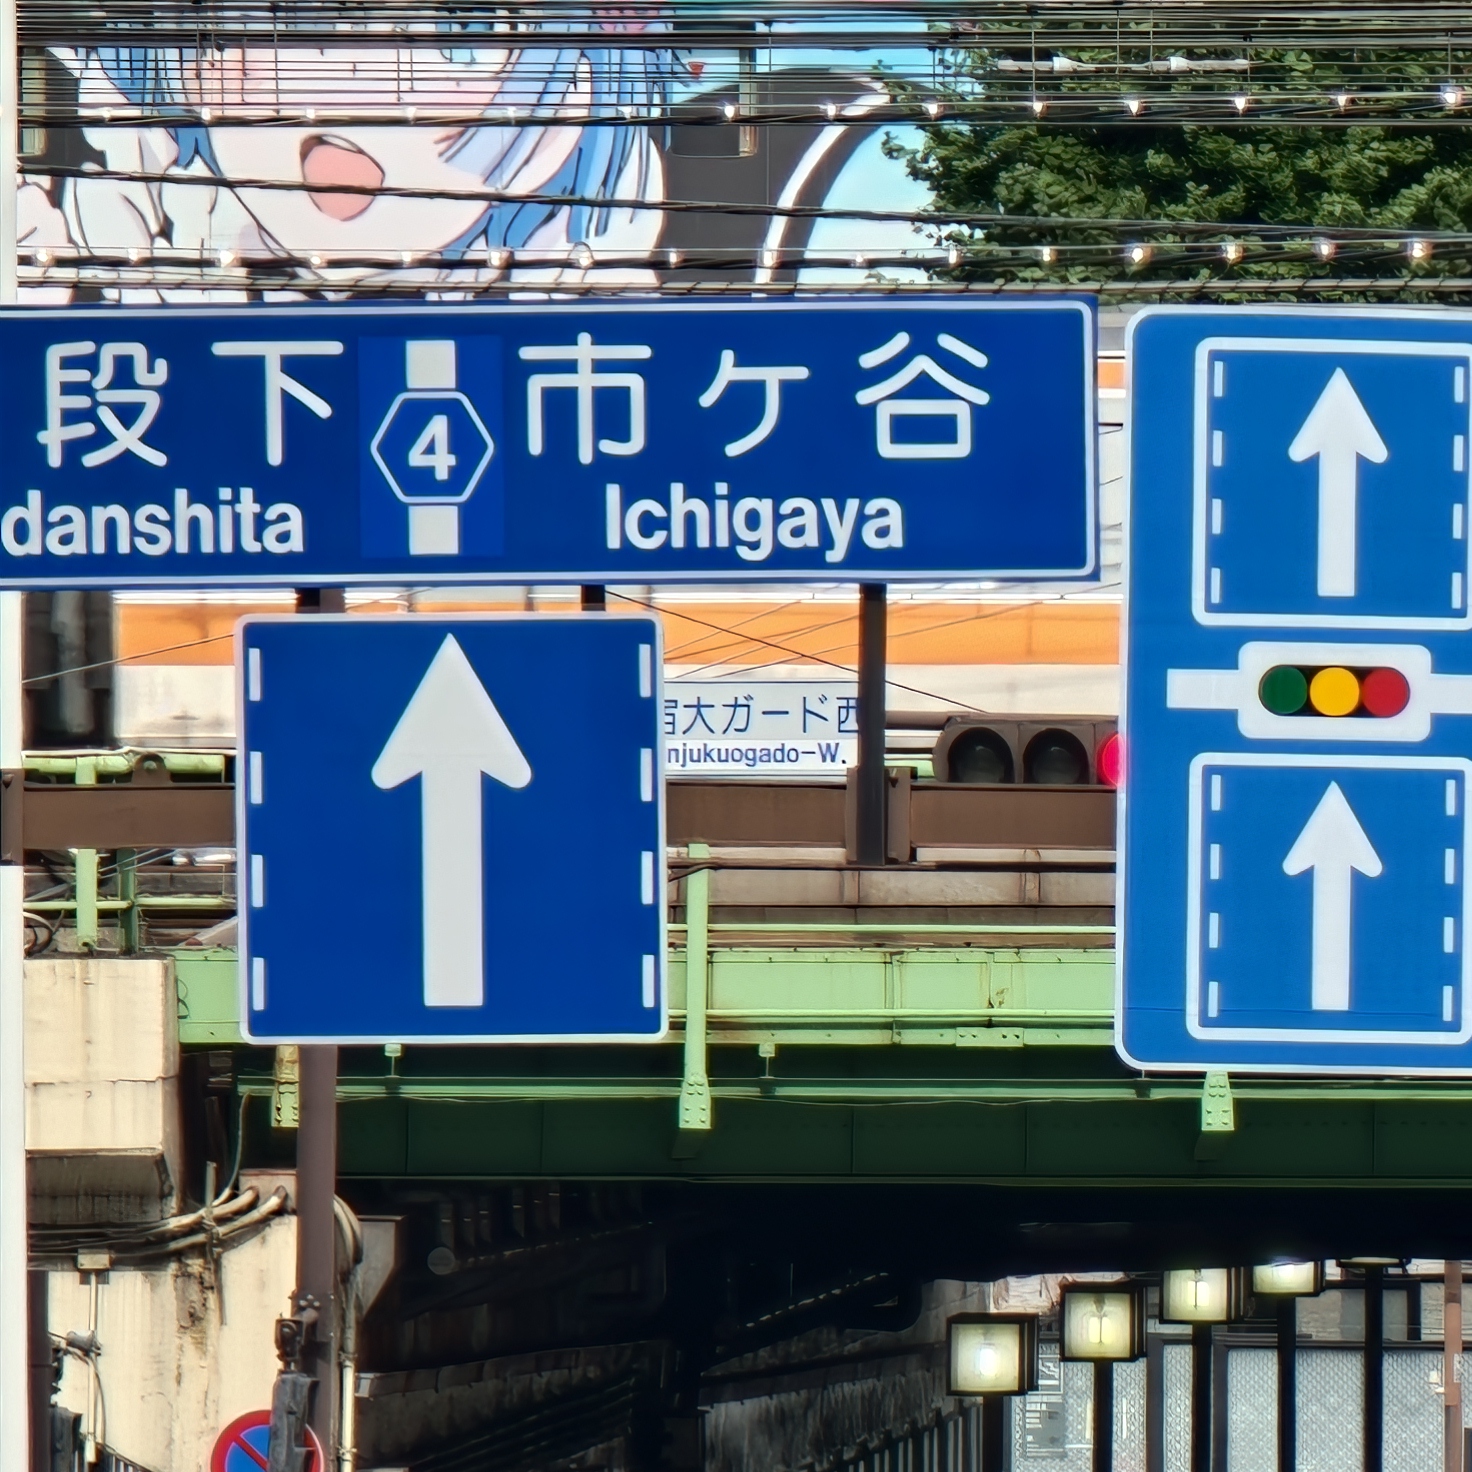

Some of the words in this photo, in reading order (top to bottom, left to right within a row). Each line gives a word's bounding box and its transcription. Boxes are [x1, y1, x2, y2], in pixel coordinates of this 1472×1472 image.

[37, 340, 344, 468] 段下
[407, 414, 457, 481] 4
[2, 487, 305, 556] danshita
[606, 483, 904, 562] Ichigaya
